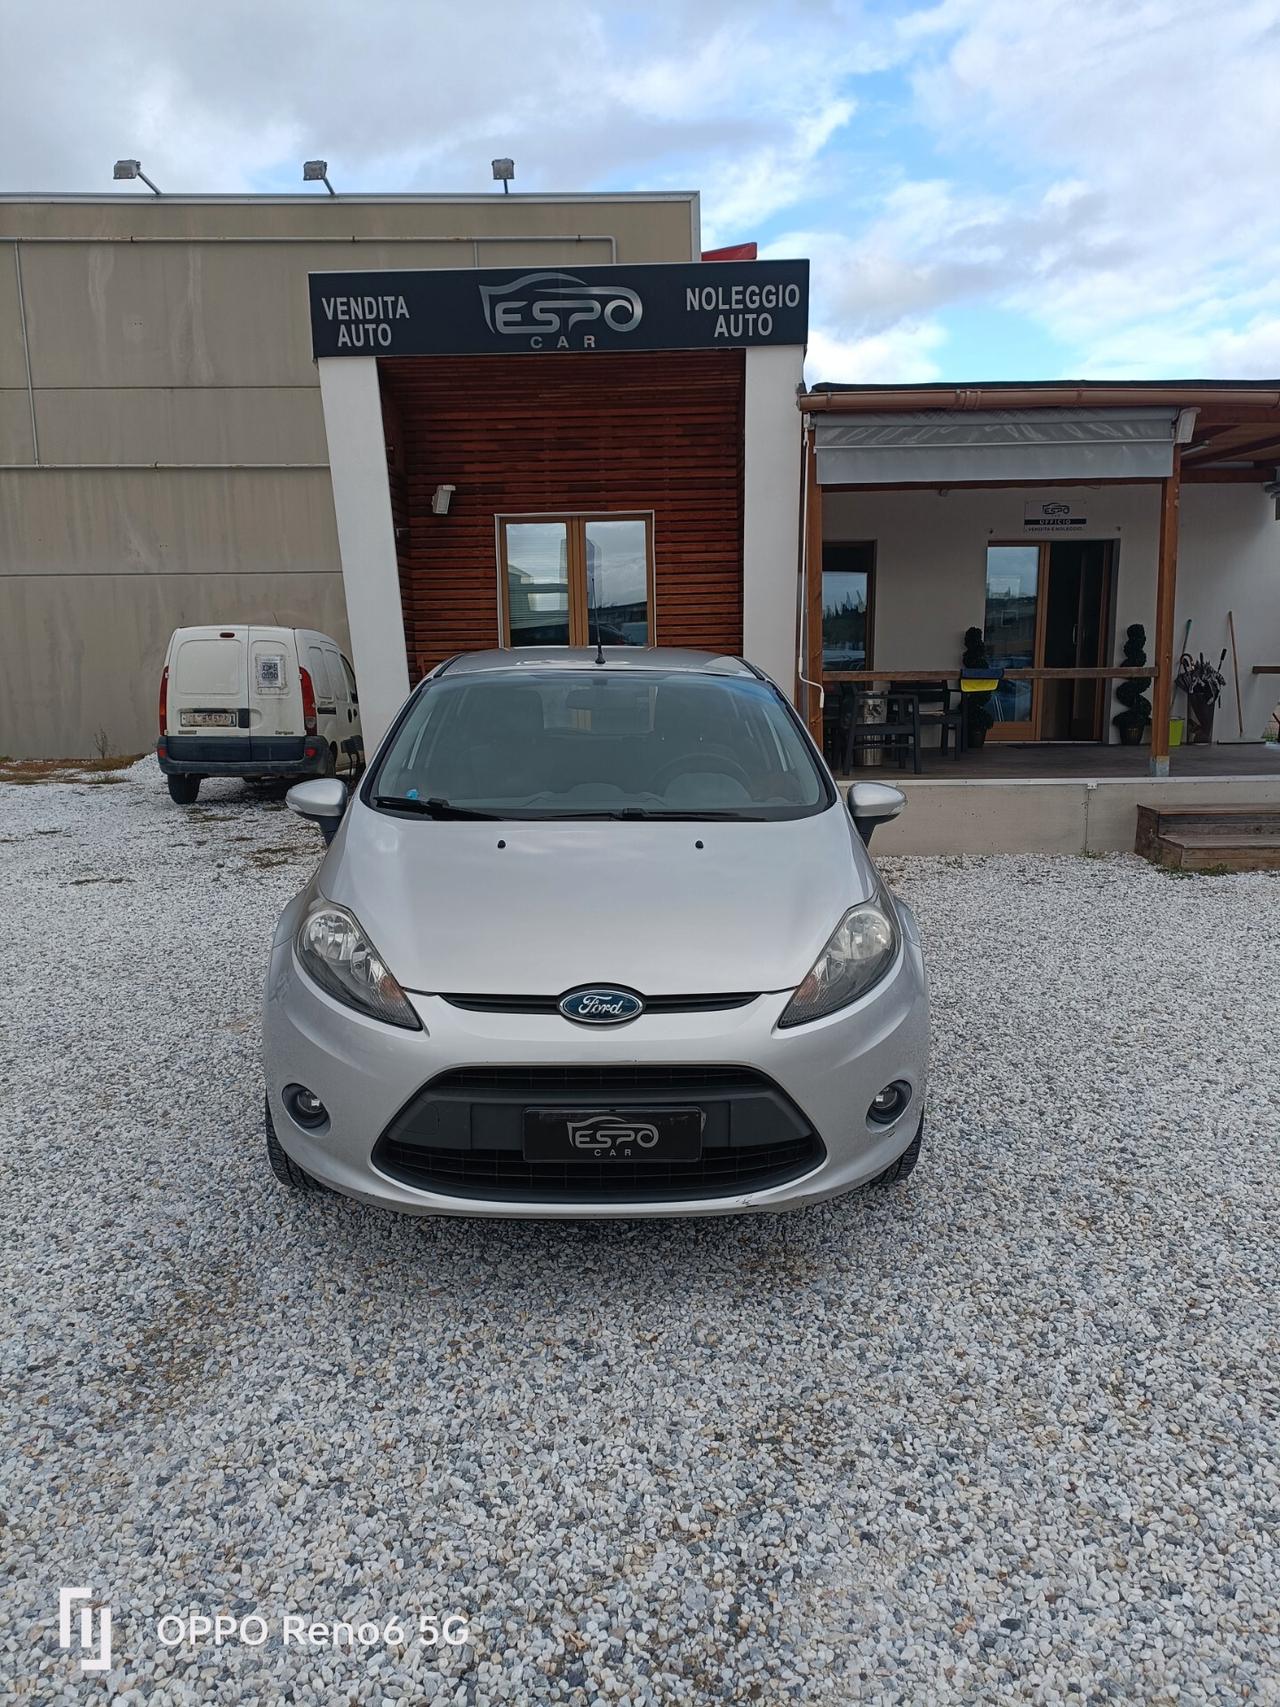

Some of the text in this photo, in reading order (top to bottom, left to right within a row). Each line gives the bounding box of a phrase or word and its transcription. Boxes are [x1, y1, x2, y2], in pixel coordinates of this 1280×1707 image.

[321, 295, 410, 321] VENDITA
[489, 286, 643, 334] ESPO
[686, 284, 801, 312] NOLEGGIO
[337, 323, 392, 347] AUTO
[714, 313, 774, 338] AUTO
[530, 335, 596, 349] CAR
[578, 995, 624, 1014] Ford
[571, 1124, 660, 1148] ESPO
